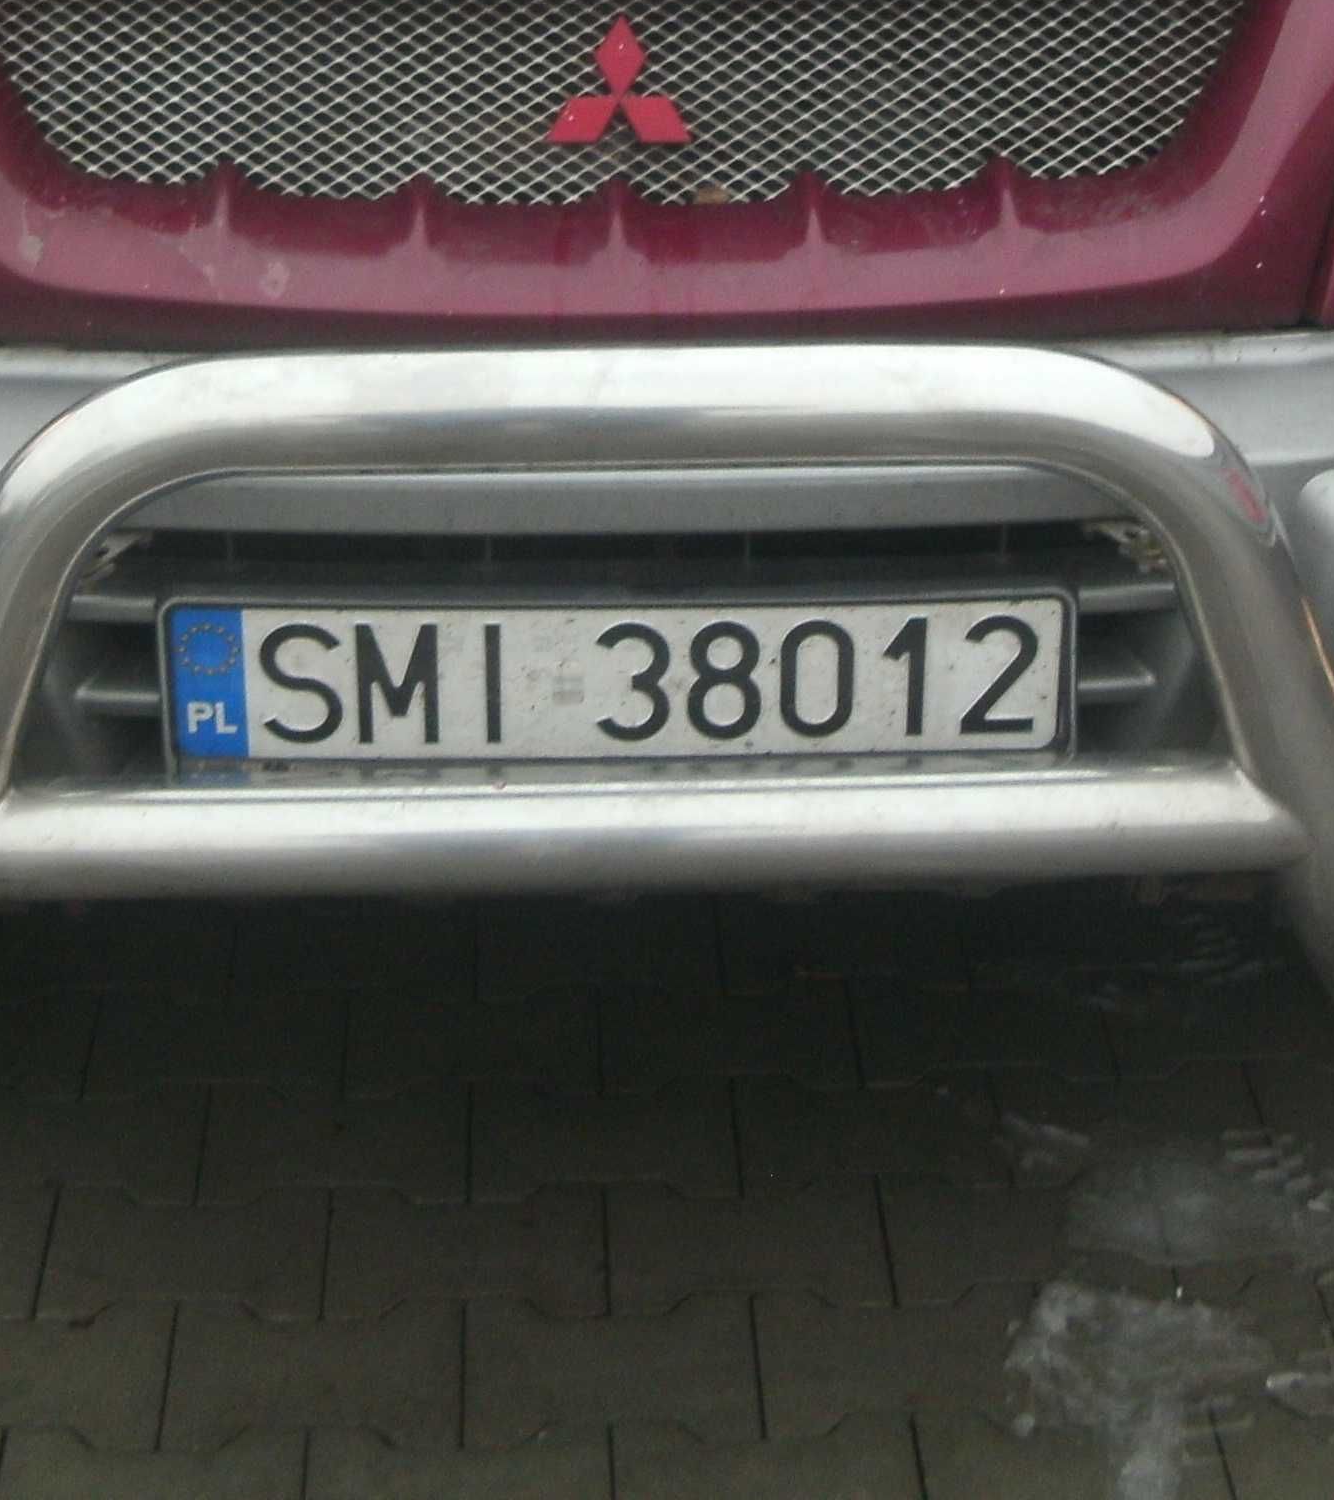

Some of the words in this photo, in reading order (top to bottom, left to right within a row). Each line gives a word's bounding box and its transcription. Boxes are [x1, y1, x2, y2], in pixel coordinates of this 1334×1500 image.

[187, 701, 238, 734] PL
[259, 623, 502, 744] SMI
[596, 616, 1039, 742] 38012
